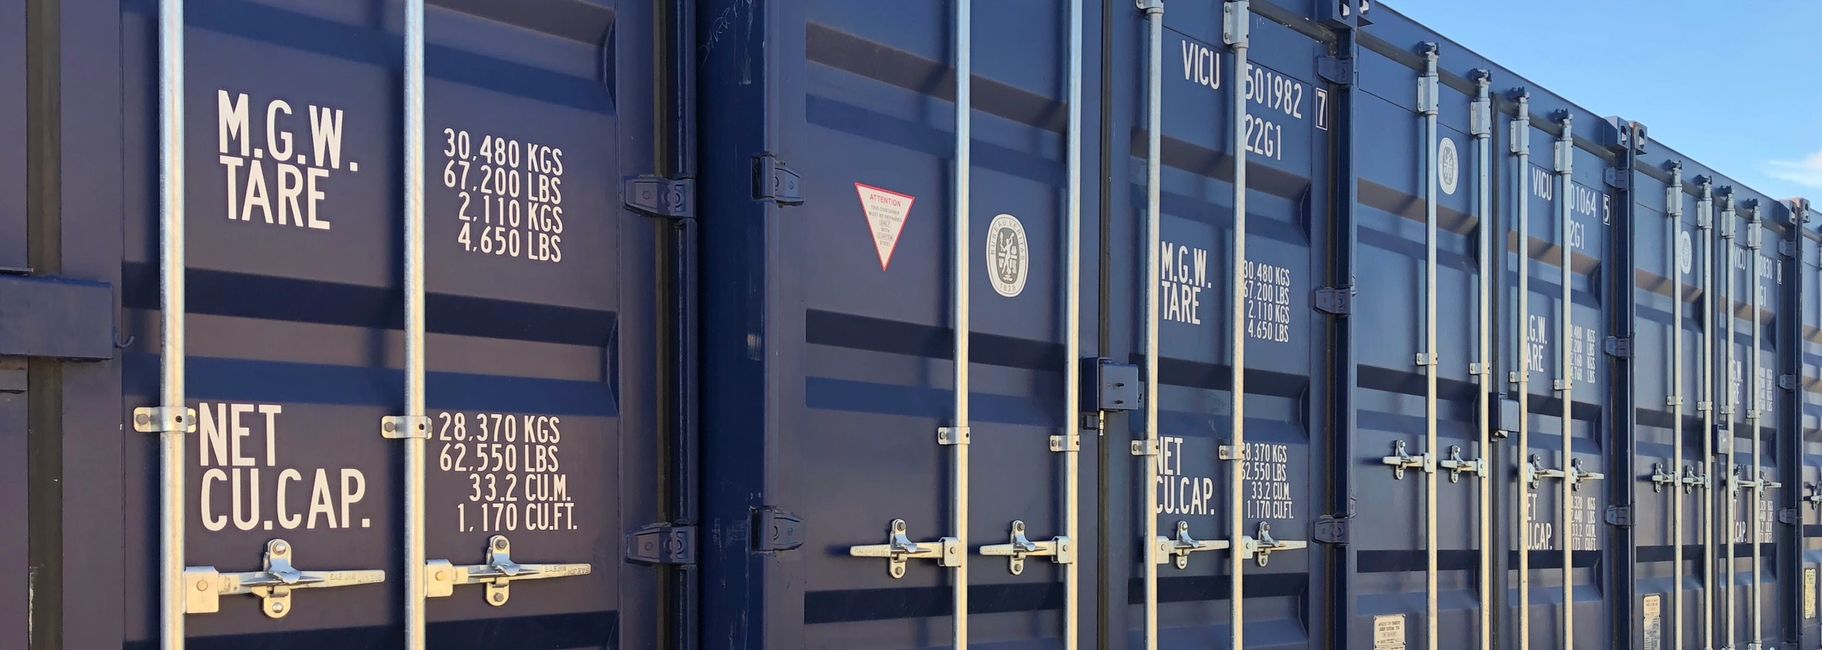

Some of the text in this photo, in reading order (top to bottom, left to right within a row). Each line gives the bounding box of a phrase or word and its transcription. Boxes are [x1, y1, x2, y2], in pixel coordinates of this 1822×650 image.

[1182, 40, 1220, 90] VICU
[1246, 63, 1302, 119] 501982
[218, 89, 358, 172] M.G.W.
[1245, 114, 1282, 161] 22G1
[443, 127, 563, 176] 30,480 KGS
[219, 154, 331, 230] TARE
[443, 159, 562, 205] 67,200 LBS
[1532, 167, 1553, 202] VICU
[1570, 184, 1597, 218] 01064
[458, 191, 563, 234] 2,110 KGS
[869, 193, 902, 207] ATTENTION
[458, 222, 562, 263] 4,650 LBS
[1570, 220, 1585, 250] 2G1
[1161, 241, 1212, 289] M.G.W.
[1275, 266, 1290, 287] KGS
[1161, 281, 1201, 325] TARE
[1275, 285, 1290, 305] LBS
[1275, 304, 1290, 324] KGS
[1527, 314, 1548, 345] .G.W.
[1274, 323, 1289, 342] LBS
[1527, 343, 1545, 373] ARE
[199, 402, 282, 467] NET
[439, 411, 561, 444] 28,370 KGS
[439, 442, 559, 473] 62,550 LBS
[1157, 436, 1183, 475] NET
[1272, 444, 1287, 463] KGS
[469, 473, 572, 502] 33.2 CU.M.
[1272, 463, 1287, 482] LBS
[201, 468, 371, 531] CU.CAP.
[1156, 475, 1215, 515] CU.CAP.
[1251, 481, 1271, 500] 33.2
[457, 502, 578, 532] 1,170 CU.FT.
[1527, 493, 1538, 521] ET
[1527, 522, 1553, 550] U.CAP.
